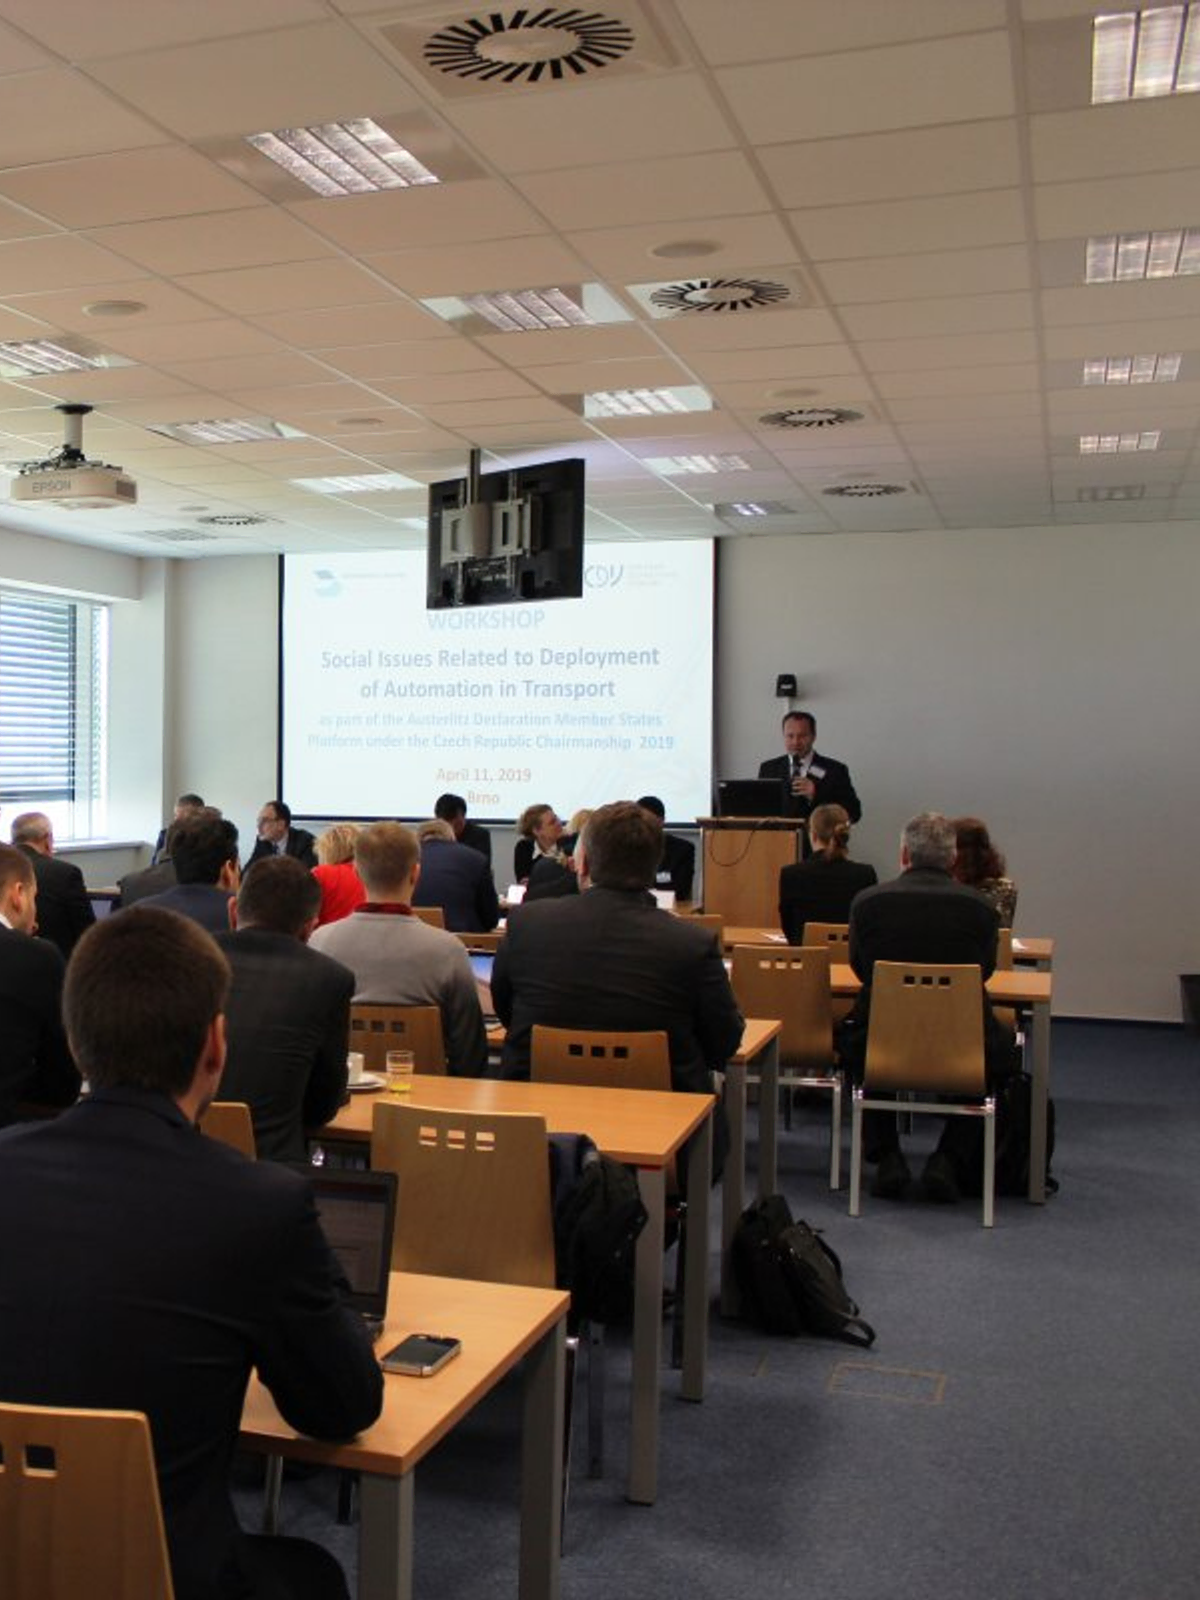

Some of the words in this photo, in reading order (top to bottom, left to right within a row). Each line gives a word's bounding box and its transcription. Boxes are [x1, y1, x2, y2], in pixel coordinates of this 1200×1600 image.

[31, 480, 72, 494] EPSON
[428, 610, 545, 631] WORKSHOP
[321, 650, 372, 669] Social
[378, 652, 433, 668] Issues
[438, 649, 507, 666] Related
[514, 650, 533, 666] to
[539, 647, 660, 670] Deployment
[360, 681, 378, 698] of
[384, 681, 493, 698] Automation
[500, 681, 516, 697] in
[522, 681, 615, 701] Transport
[319, 715, 333, 726] as
[336, 713, 362, 729] part
[365, 712, 380, 726] of
[382, 712, 403, 726] the
[407, 712, 470, 726] Austerlitz
[474, 712, 551, 726] Declaration
[554, 712, 614, 726] Member
[619, 712, 663, 726] States
[308, 735, 363, 749] Platform
[366, 736, 405, 748] under
[407, 735, 430, 748] the
[434, 735, 471, 748] Czech
[474, 735, 531, 750] Republic
[535, 735, 632, 751] Chairmanship
[640, 736, 674, 749] 2019
[436, 768, 470, 783] April
[474, 769, 494, 783] 11,
[498, 768, 532, 781] 2019
[467, 791, 499, 804] Brno
